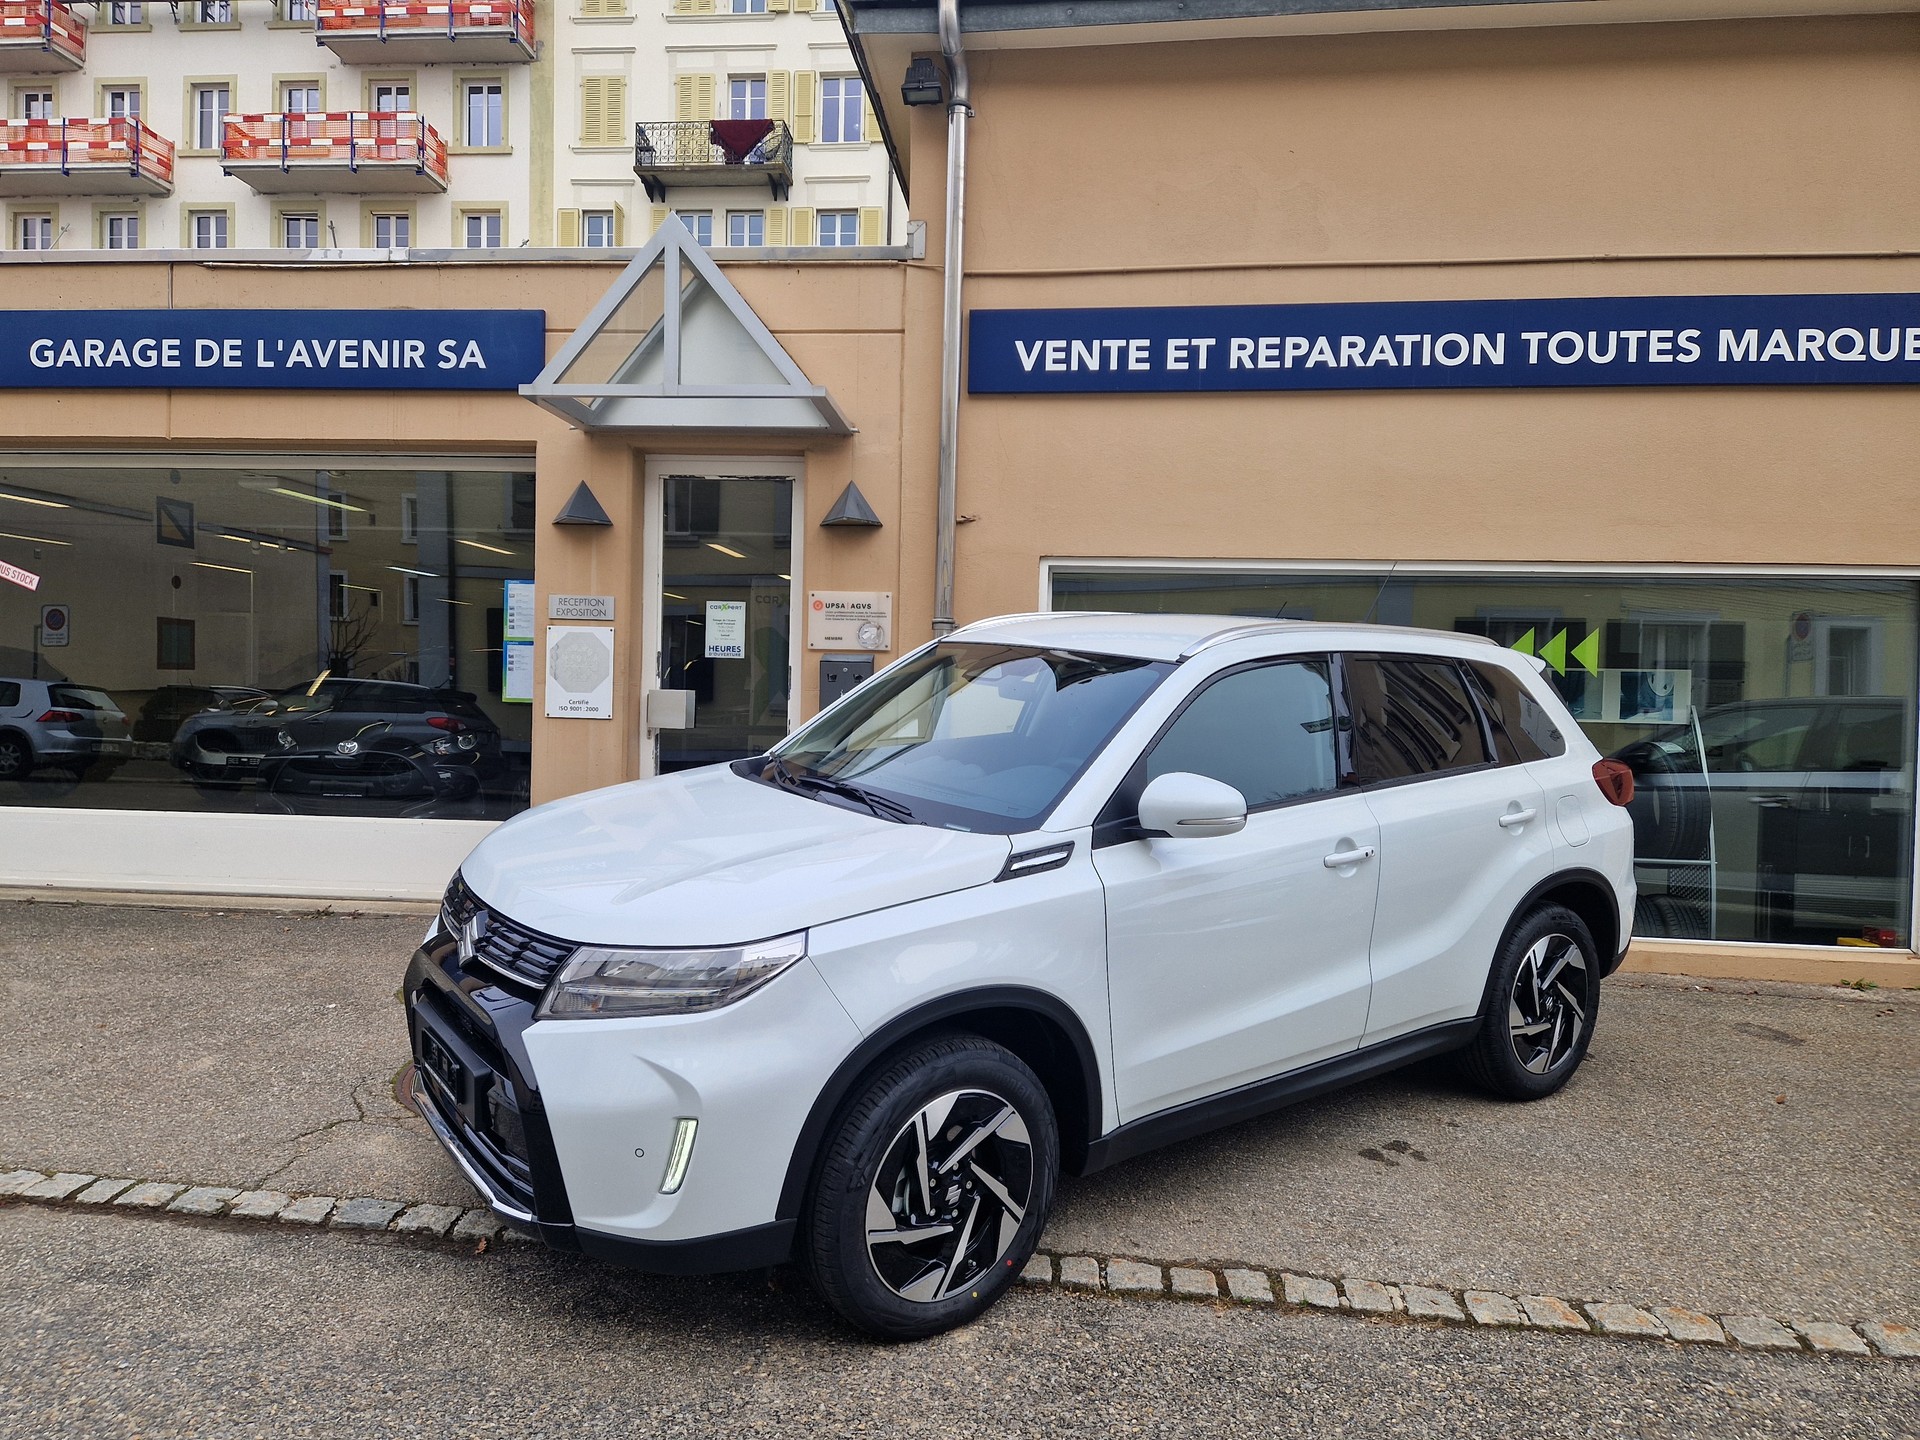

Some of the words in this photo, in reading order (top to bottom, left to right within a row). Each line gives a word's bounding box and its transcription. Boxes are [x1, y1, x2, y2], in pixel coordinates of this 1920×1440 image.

[29, 338, 181, 368] GARAGE
[194, 339, 242, 368] DE
[257, 339, 426, 369] L'AVENIR
[437, 339, 487, 370] SA
[1014, 338, 1151, 372] VENTE
[1166, 338, 1216, 370] ET
[1229, 332, 1506, 369] REPARATION
[1521, 329, 1701, 365] TOUTES
[0, 564, 11, 577] US
[11, 569, 35, 587] STOCK
[558, 597, 605, 607] RECEPTION
[556, 607, 607, 617] EXPOSITION
[708, 645, 742, 653] HEURES
